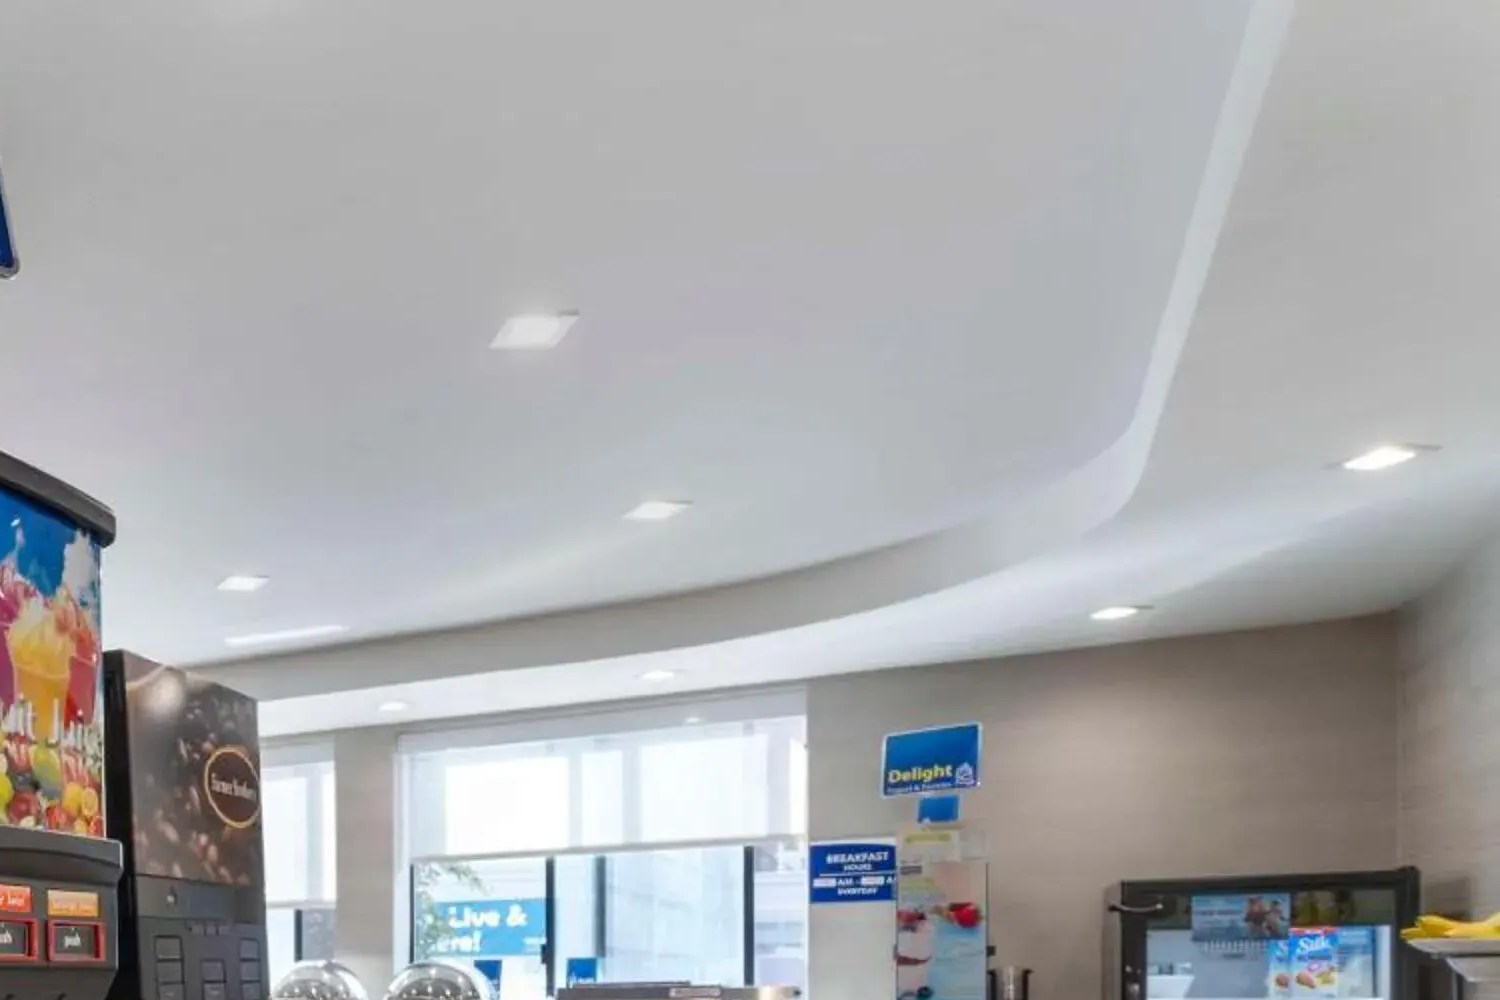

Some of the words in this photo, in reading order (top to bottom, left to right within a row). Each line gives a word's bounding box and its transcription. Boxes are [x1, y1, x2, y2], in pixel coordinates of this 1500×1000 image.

[888, 764, 953, 783] Delight
[826, 850, 889, 865] BREAKFAST
[448, 906, 501, 929] Live
[506, 903, 528, 927] &
